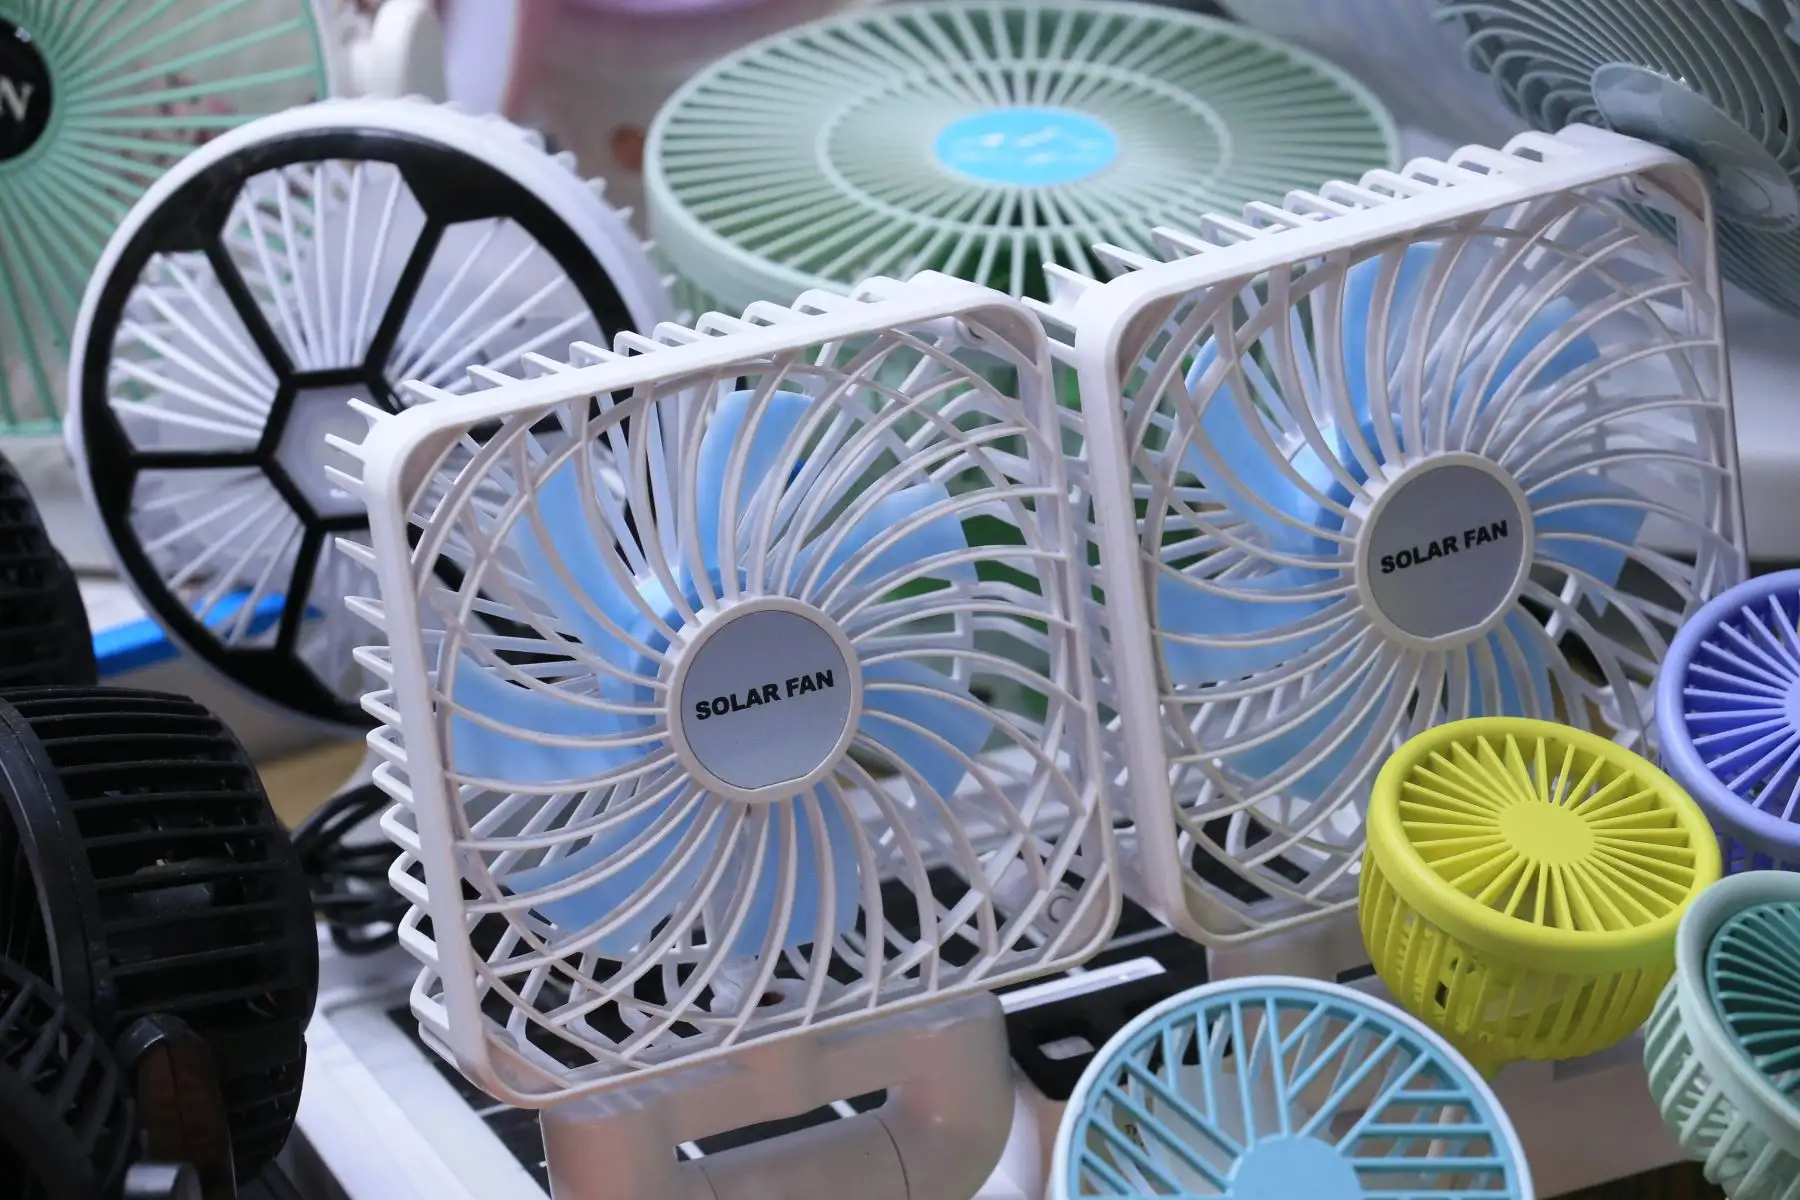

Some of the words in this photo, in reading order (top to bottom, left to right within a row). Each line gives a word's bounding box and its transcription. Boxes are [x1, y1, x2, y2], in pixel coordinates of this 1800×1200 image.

[1380, 535, 1460, 574] SOLAR
[1463, 519, 1509, 550] FAN
[695, 683, 782, 721] SOLAR
[785, 669, 834, 698] FAN
